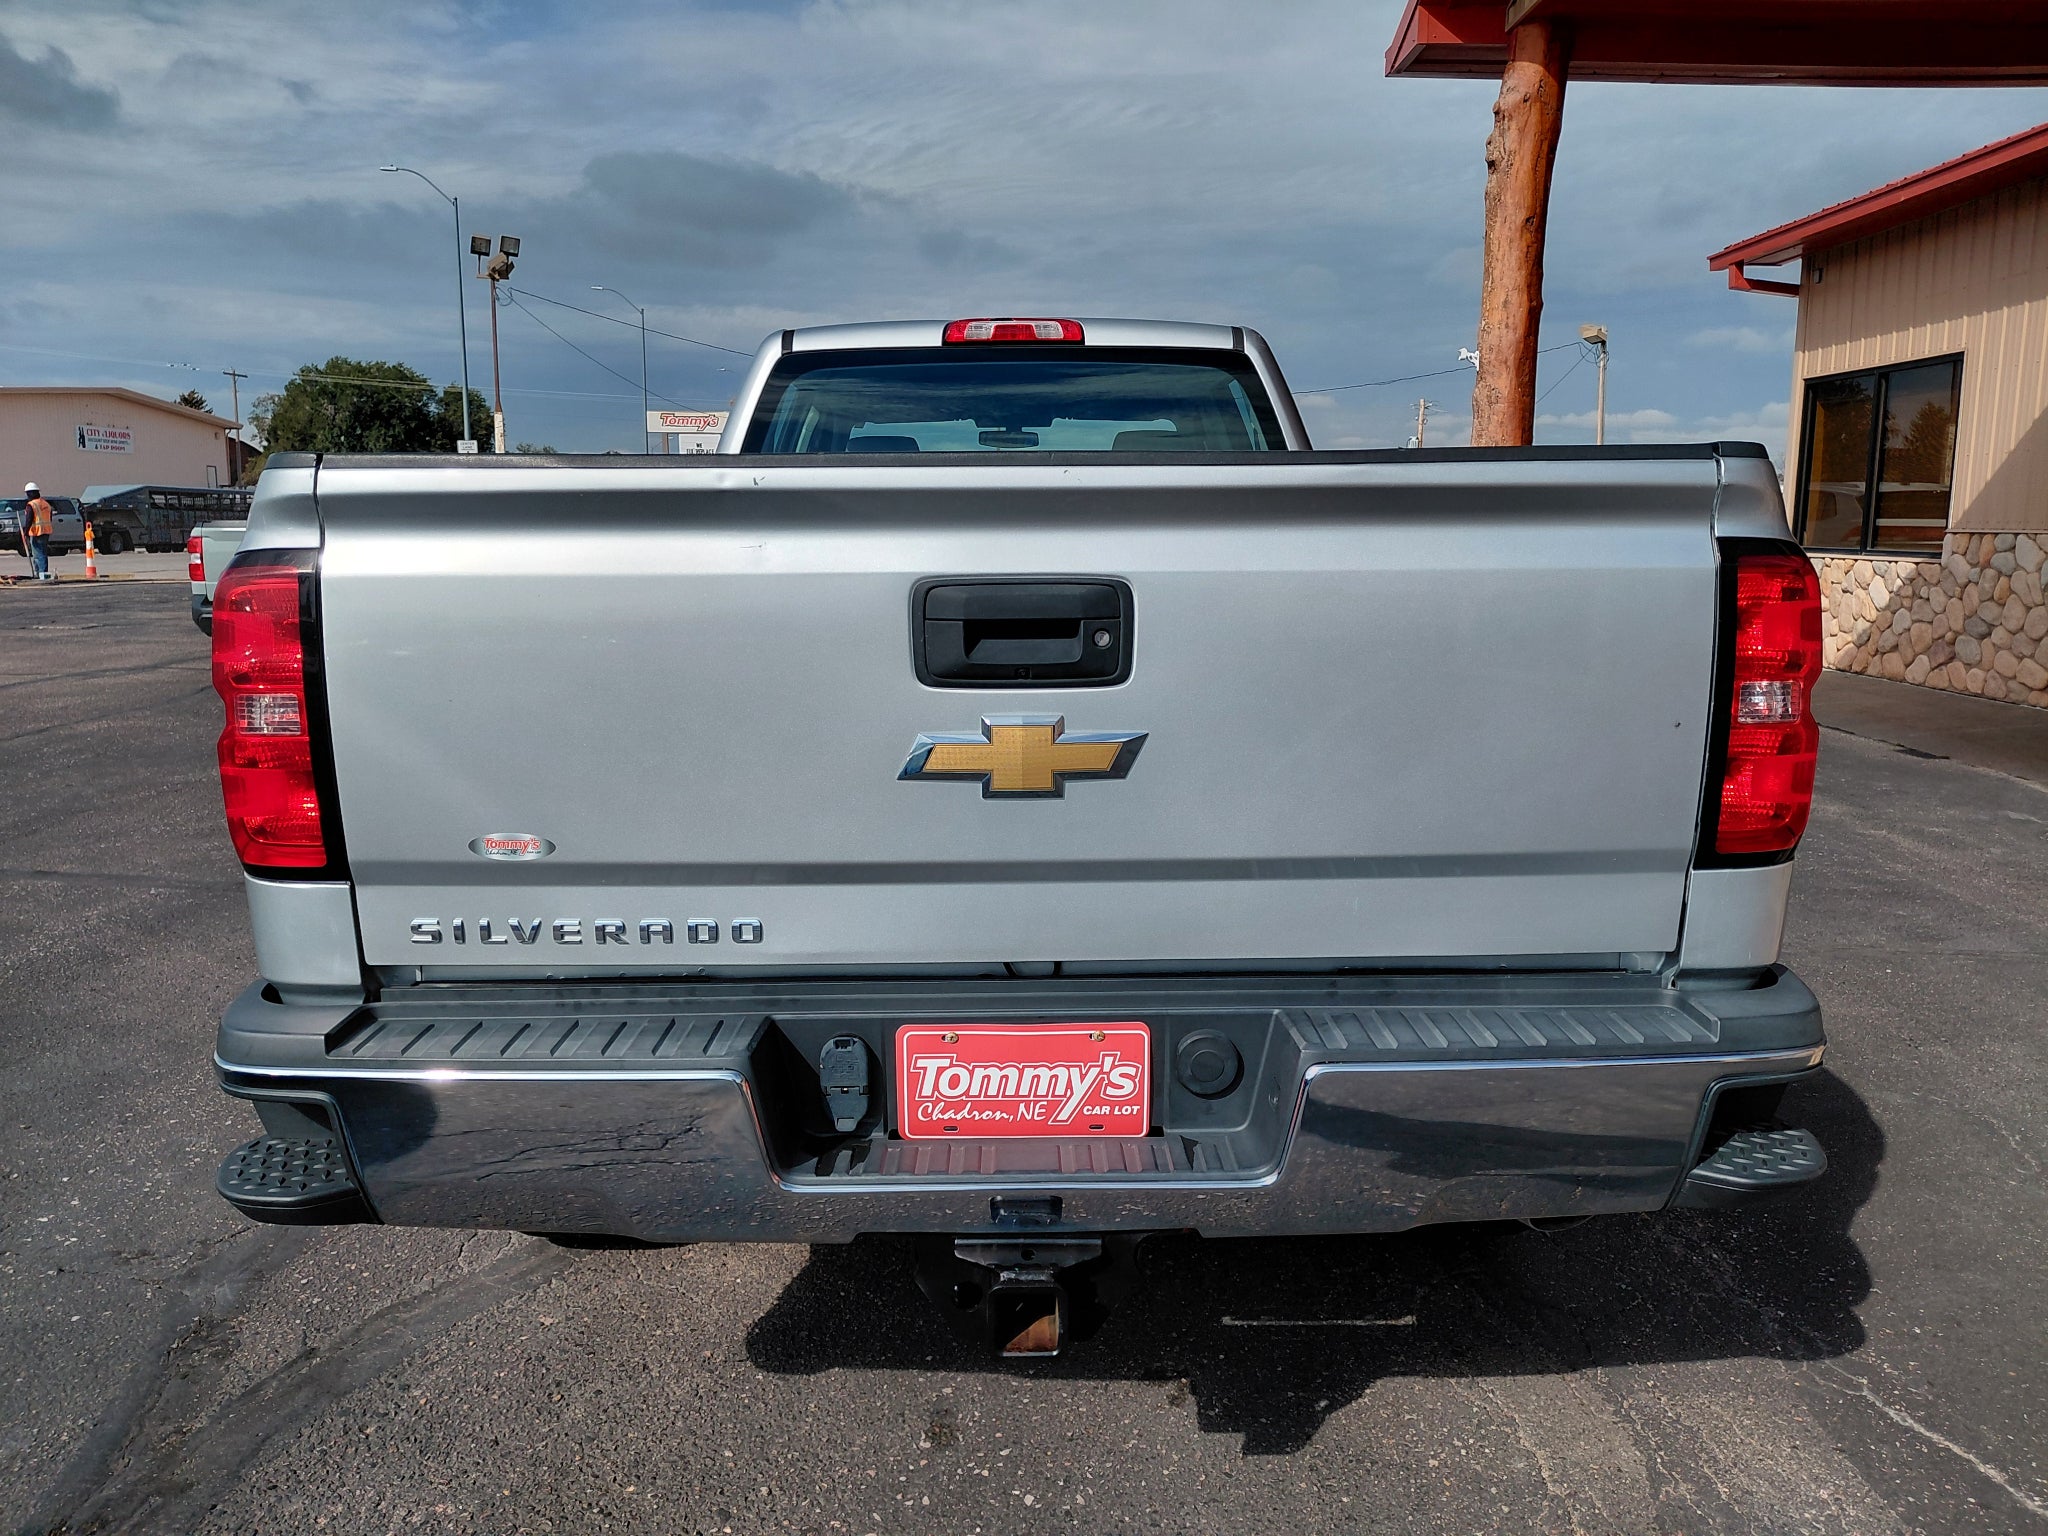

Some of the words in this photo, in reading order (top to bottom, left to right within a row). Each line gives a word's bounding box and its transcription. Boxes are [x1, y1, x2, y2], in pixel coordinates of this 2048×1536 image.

[660, 413, 719, 431] Tommy's
[87, 429, 100, 437] CITY
[105, 431, 130, 440] LIQUORS
[482, 837, 541, 857] Tommy's
[410, 917, 764, 945] SILVERADO
[911, 1052, 1143, 1125] Tommy's
[1016, 1100, 1049, 1122] NE
[1082, 1104, 1112, 1116] CAR
[1114, 1104, 1141, 1115] LOT
